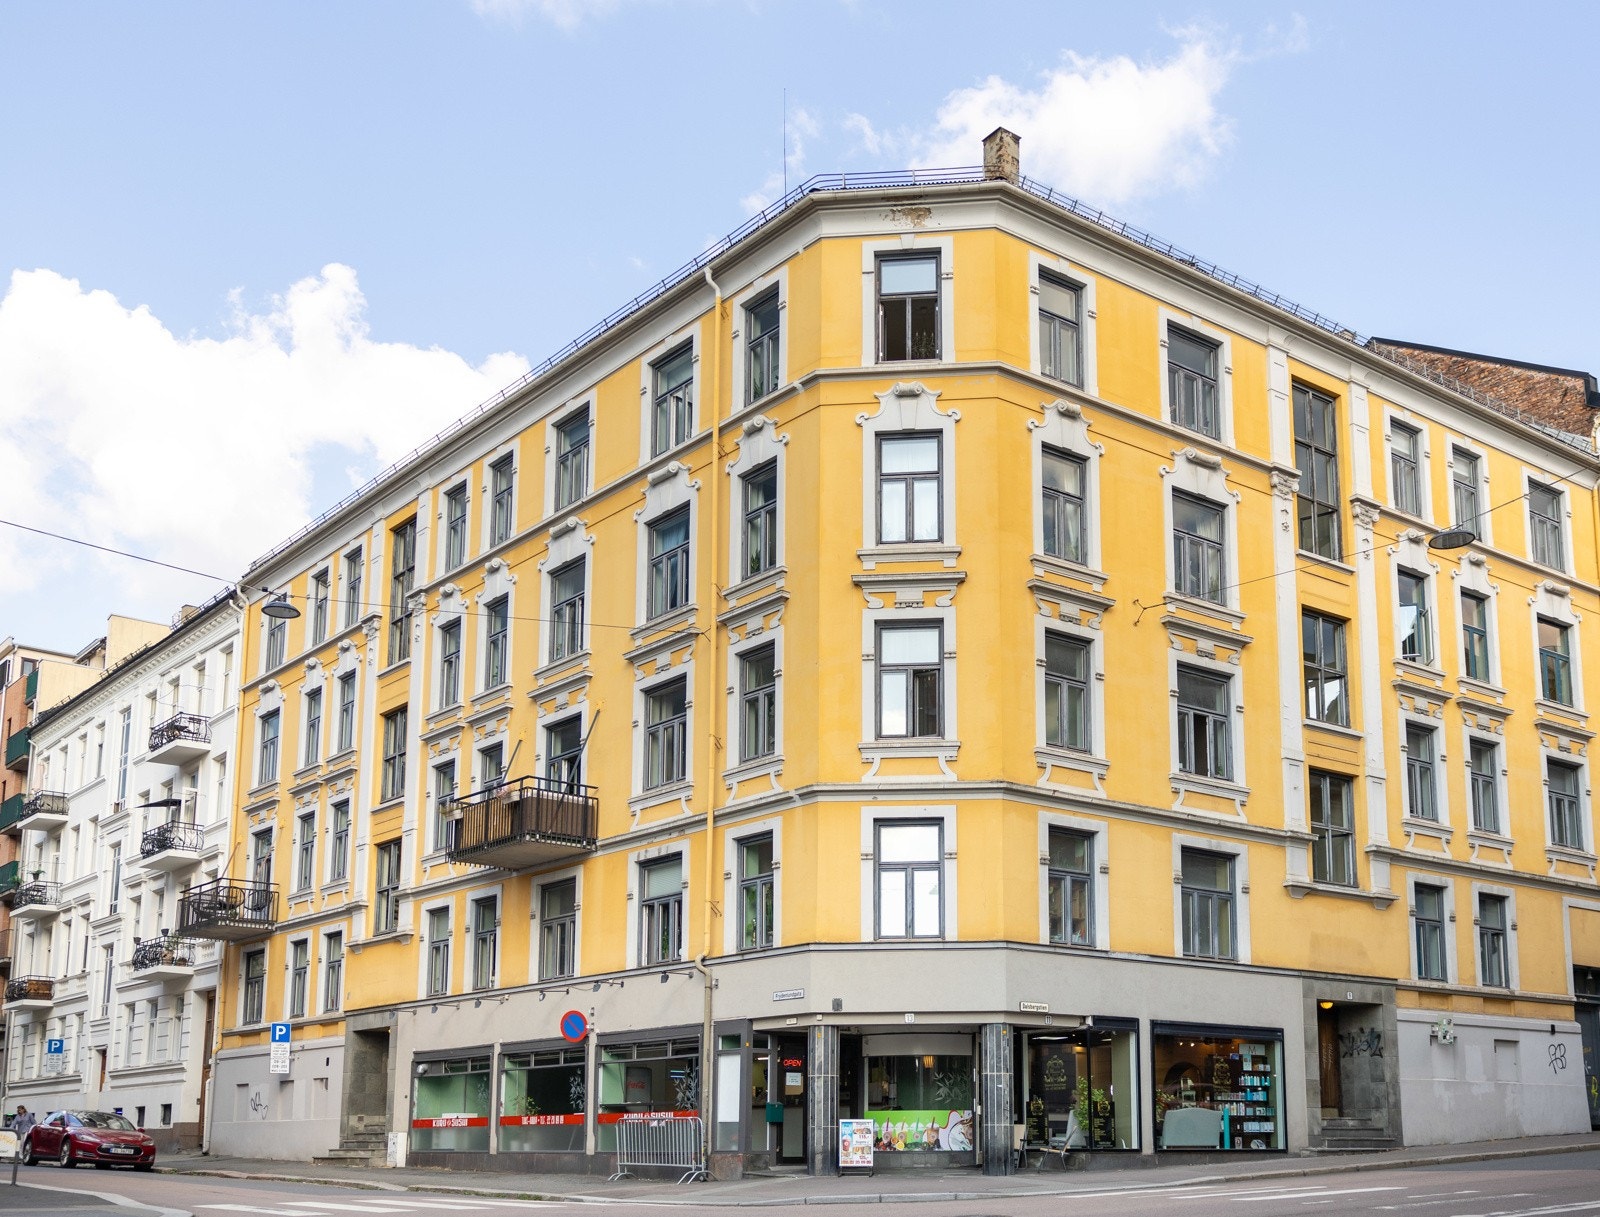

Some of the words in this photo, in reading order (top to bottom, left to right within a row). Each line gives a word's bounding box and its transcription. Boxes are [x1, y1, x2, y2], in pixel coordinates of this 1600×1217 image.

[1022, 1003, 1048, 1011] Dalsbergstien
[1046, 1016, 1051, 1024] 11
[275, 1025, 287, 1041] P
[51, 1040, 61, 1052] P
[783, 1059, 802, 1067] OPEN
[452, 1118, 468, 1127] SUSHI
